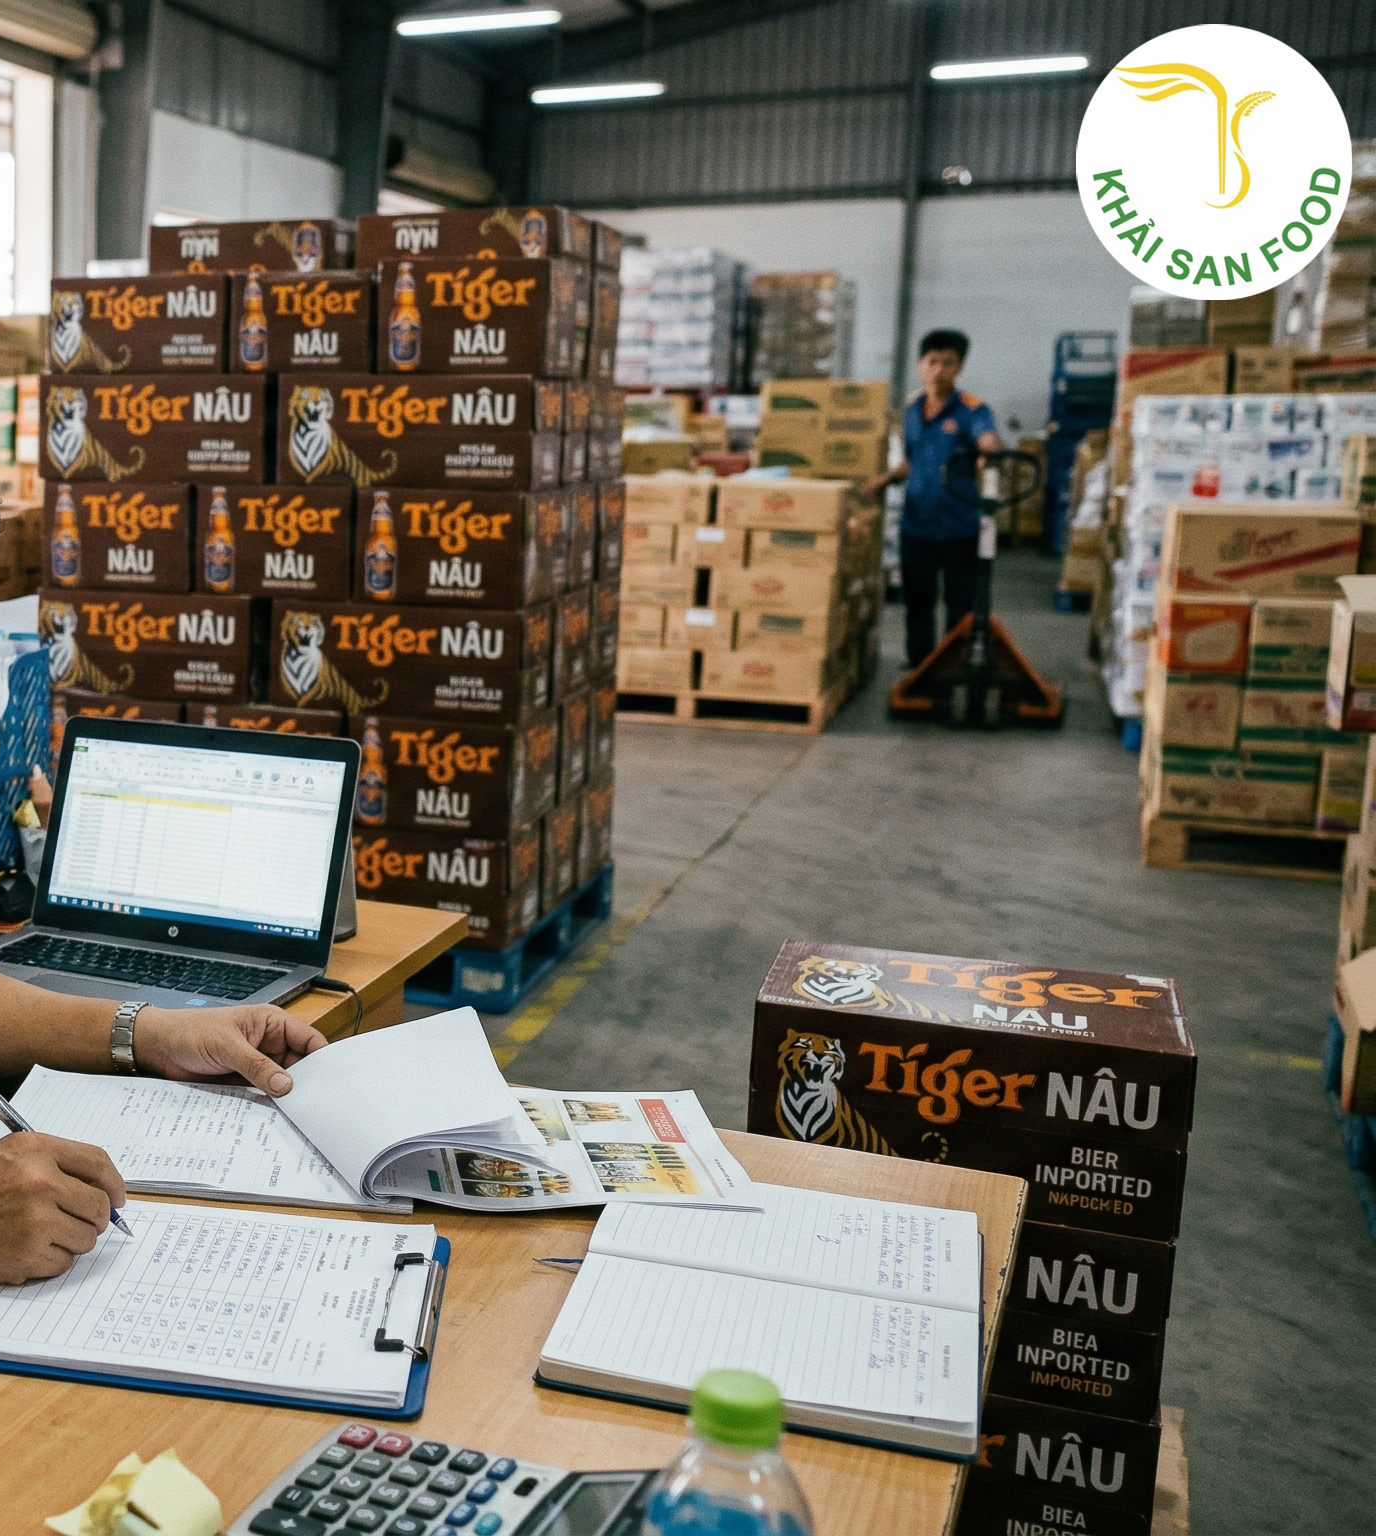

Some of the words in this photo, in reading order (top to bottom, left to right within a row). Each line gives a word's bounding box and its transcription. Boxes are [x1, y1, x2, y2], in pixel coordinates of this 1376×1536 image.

[86, 285, 164, 331] Tiger
[168, 286, 216, 317] NÂU
[270, 279, 362, 328] Tiger
[425, 266, 536, 321] Tiger
[294, 330, 337, 355] NÂU
[454, 325, 505, 354] NÂU
[94, 383, 190, 436] Tiger
[194, 387, 250, 421] NÂU
[341, 384, 447, 438] Tiger
[452, 388, 515, 424] NÂU
[80, 490, 180, 543] Tiger
[237, 493, 341, 548] Tiger
[400, 498, 512, 555] Tiger
[108, 545, 153, 573] NÂU
[265, 550, 313, 579] NÂU
[430, 558, 480, 587] NÂU
[81, 601, 175, 653] Tiger
[179, 610, 234, 644] NÂU
[332, 613, 436, 666] Tiger
[441, 622, 503, 658] NÂU
[390, 729, 499, 784] Tiger
[417, 787, 469, 819] NÂU
[428, 849, 488, 886] NÂU
[887, 959, 1162, 1009] Tiger
[858, 1042, 1036, 1124] Tiger
[1046, 1068, 1160, 1129] NÂU
[1035, 1164, 1152, 1198] INPORTED
[1072, 1147, 1118, 1169] BIER
[1027, 1254, 1138, 1314] NÂU
[1018, 1345, 1130, 1381] INPORTED
[1053, 1329, 1097, 1351] BIEA
[1031, 1371, 1112, 1397] IMPORTED
[1016, 1433, 1125, 1492] NÂU
[1042, 1505, 1086, 1529] BIEA
